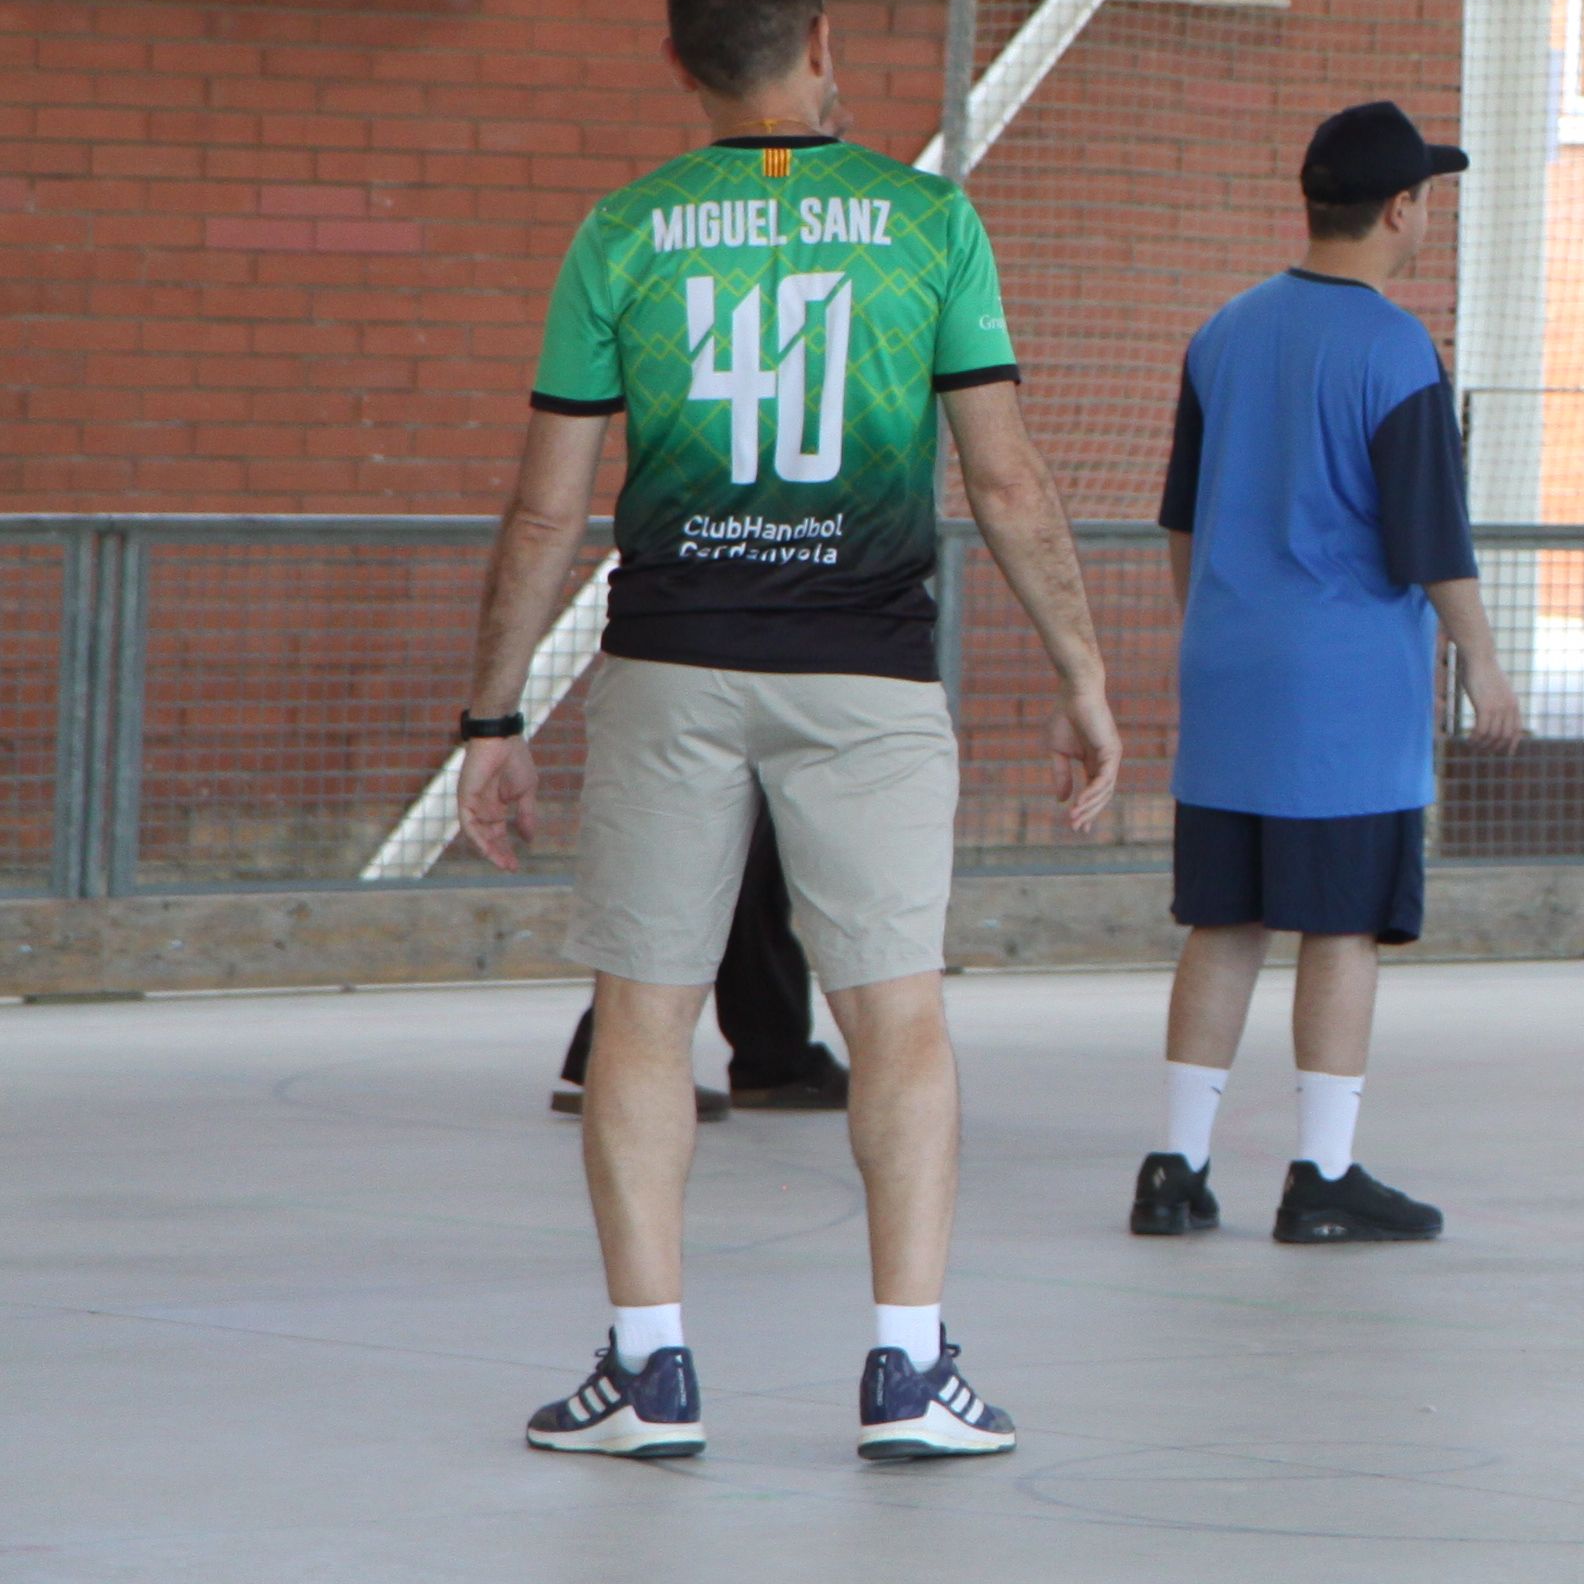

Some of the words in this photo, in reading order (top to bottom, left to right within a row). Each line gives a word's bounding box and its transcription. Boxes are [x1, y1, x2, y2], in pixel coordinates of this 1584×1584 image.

[652, 199, 788, 253] MIGUEL
[800, 197, 892, 245] SANZ
[686, 271, 853, 485] 40
